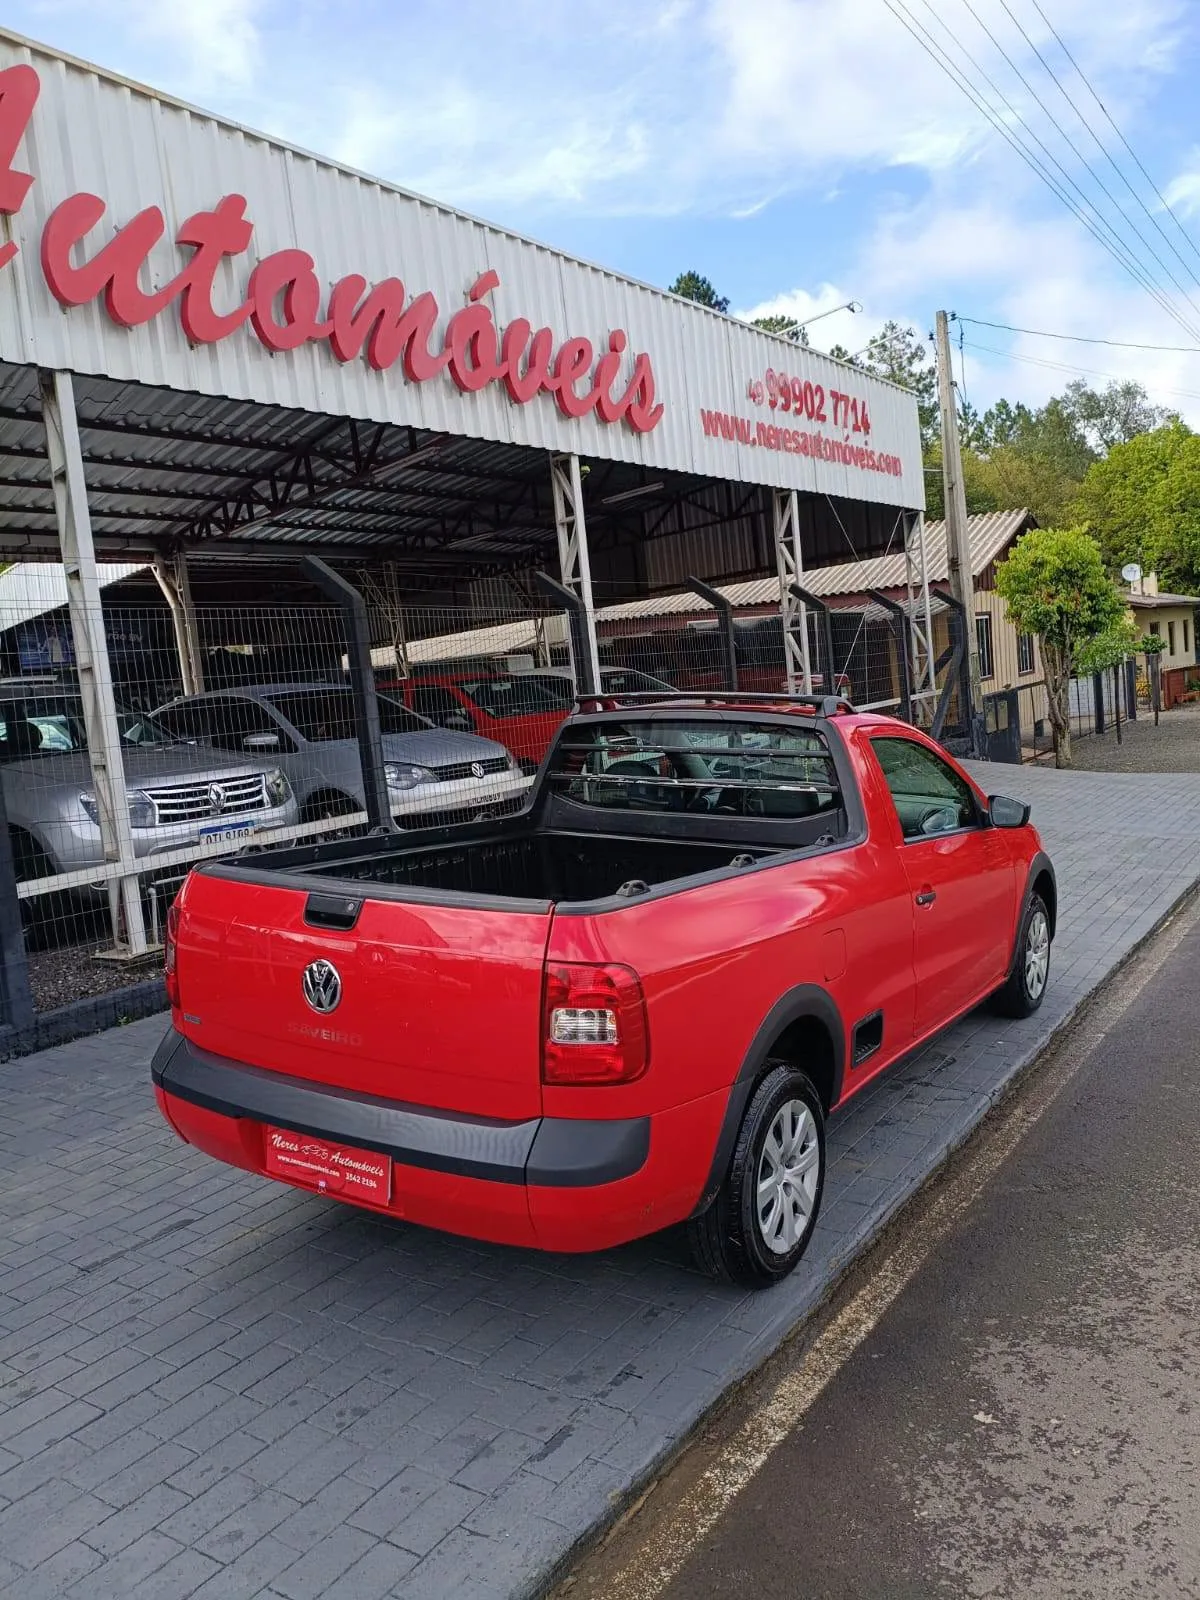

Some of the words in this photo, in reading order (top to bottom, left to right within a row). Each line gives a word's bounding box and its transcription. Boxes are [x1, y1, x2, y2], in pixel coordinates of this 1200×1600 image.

[765, 367, 827, 423] 99902
[829, 389, 871, 436] 7714
[271, 1133, 299, 1152] Neres
